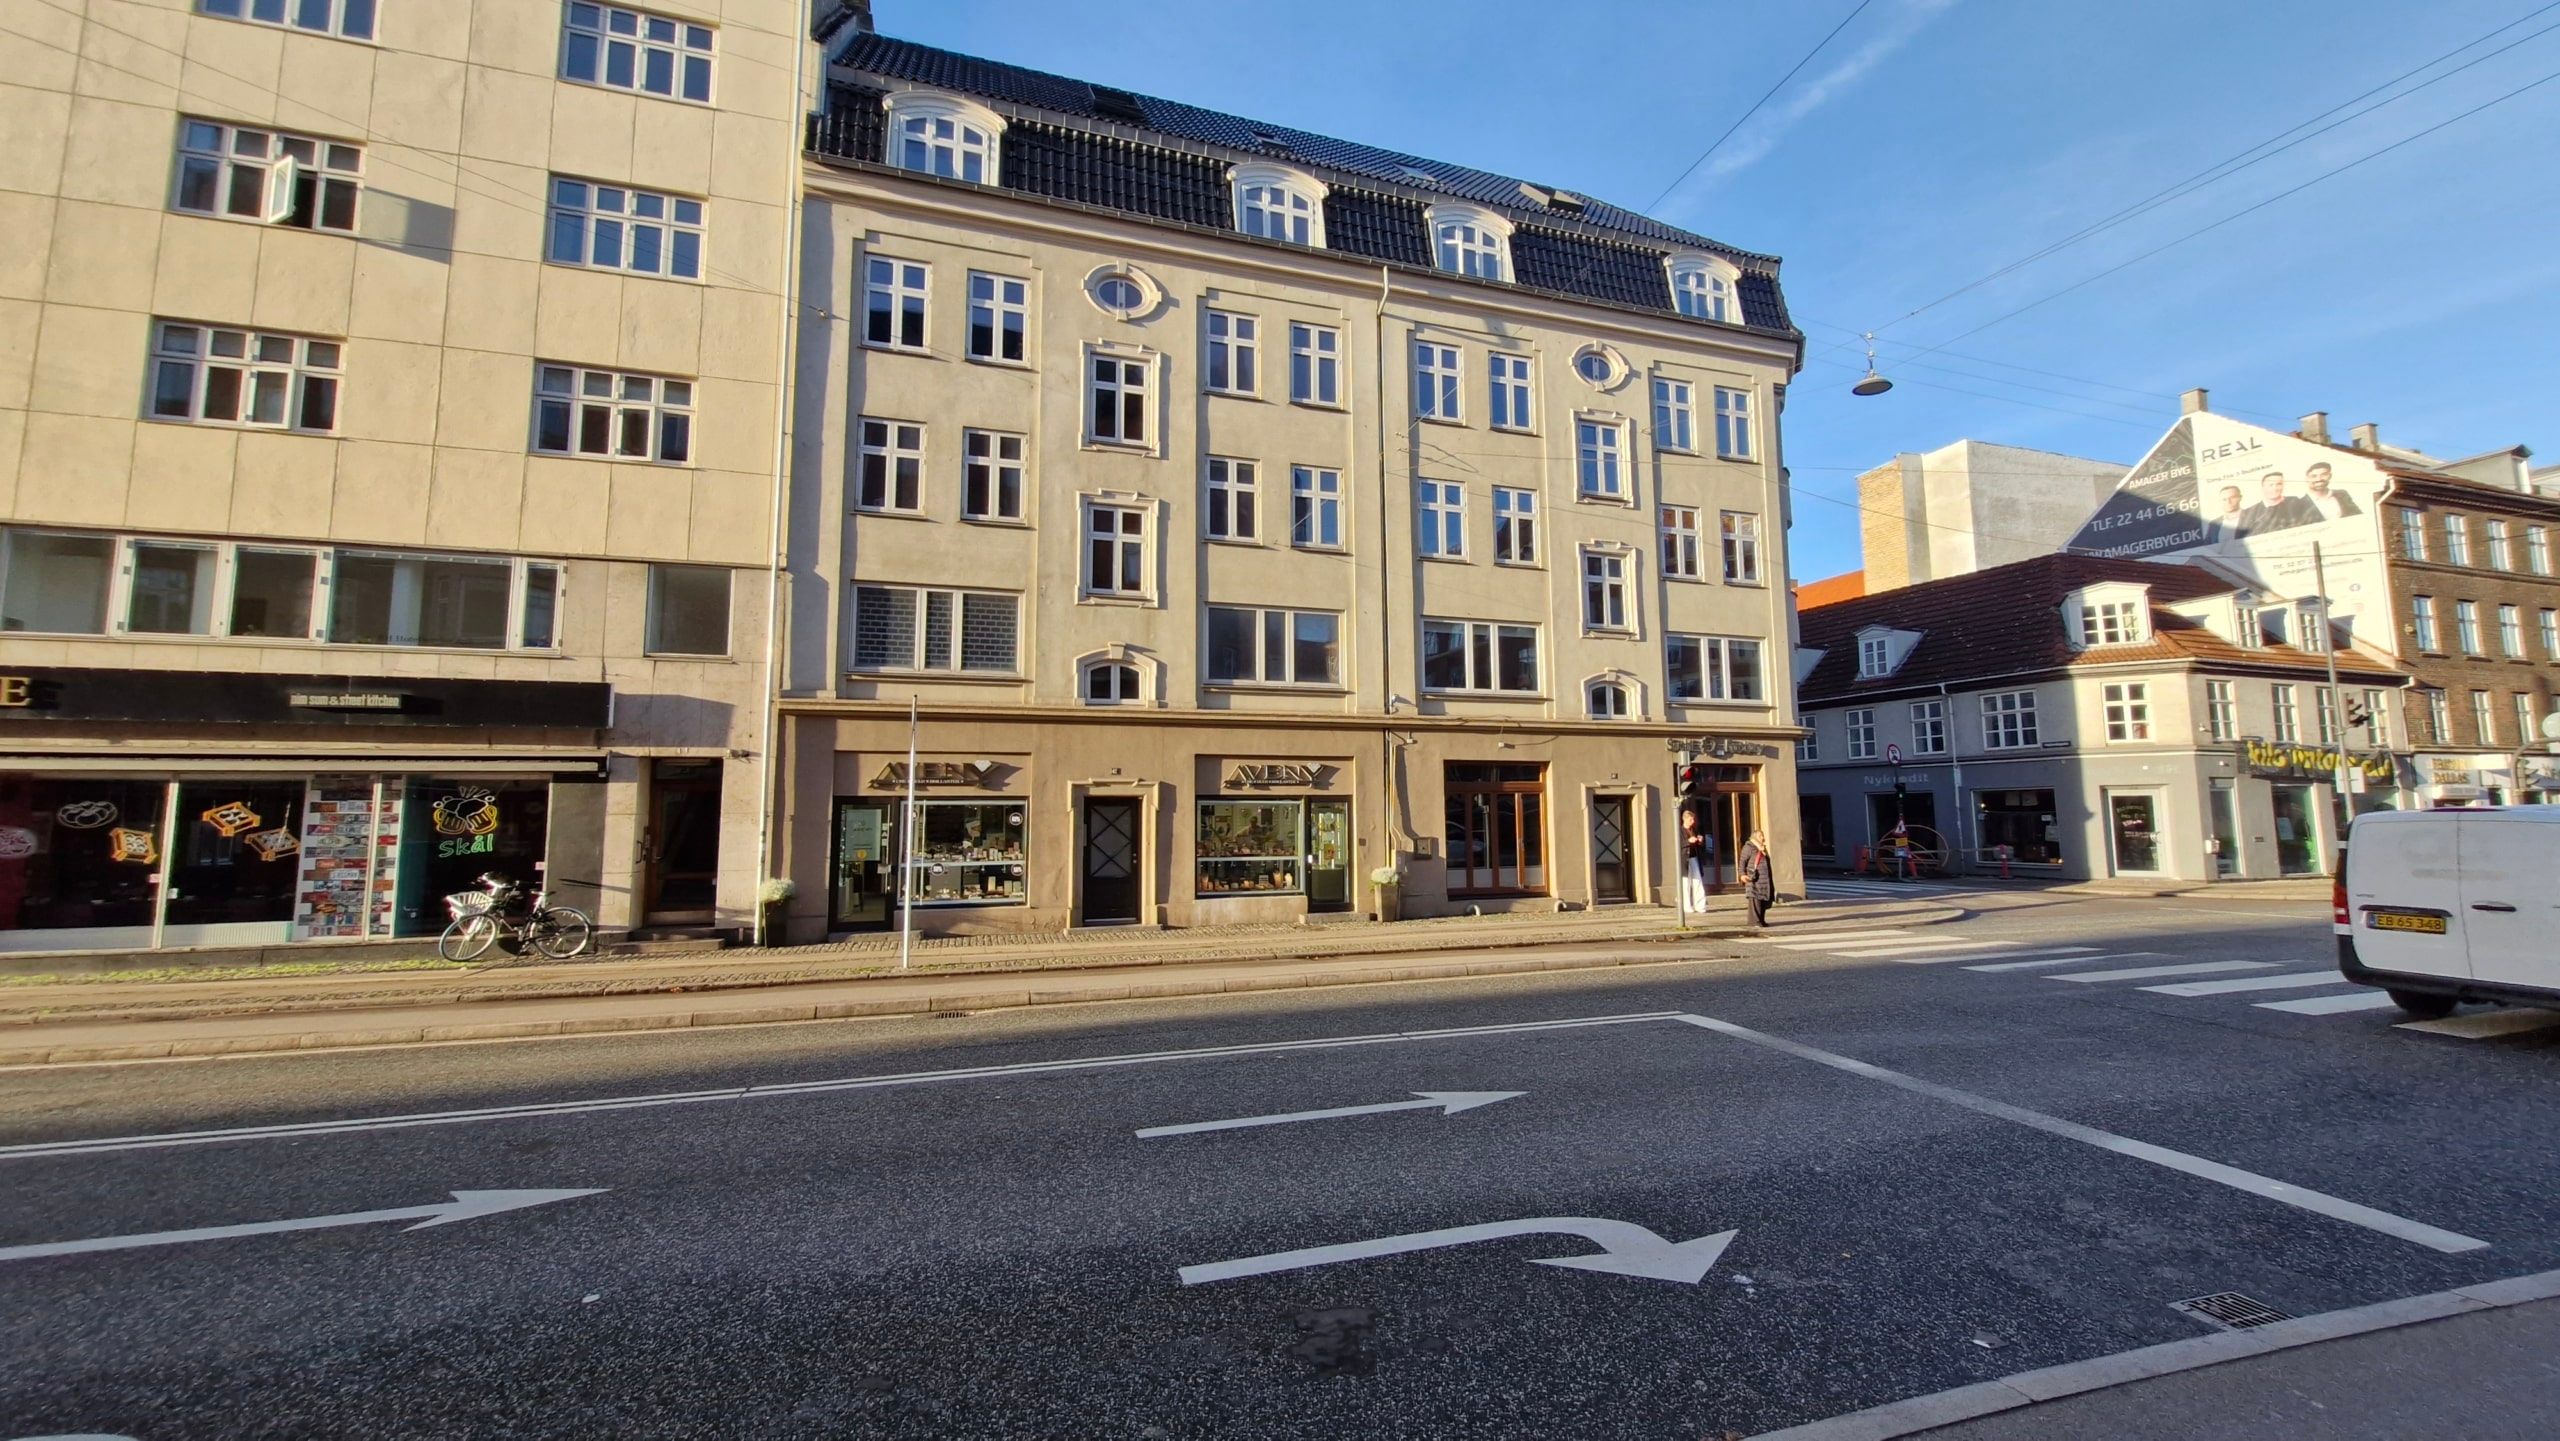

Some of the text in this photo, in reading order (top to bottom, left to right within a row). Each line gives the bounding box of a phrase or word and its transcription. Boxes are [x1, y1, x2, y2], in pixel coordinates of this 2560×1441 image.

[2202, 437, 2262, 463] REAL
[2128, 465, 2192, 490] AMAGER BYG
[2090, 497, 2199, 532] TLF. 22 44 66 66
[309, 694, 328, 705] sum
[330, 695, 339, 705] &
[340, 693, 366, 706] street
[367, 694, 400, 707] kitchen
[1222, 762, 1324, 788] AVENY
[438, 833, 494, 858] Skål
[2377, 915, 2442, 930] EB 65 348
